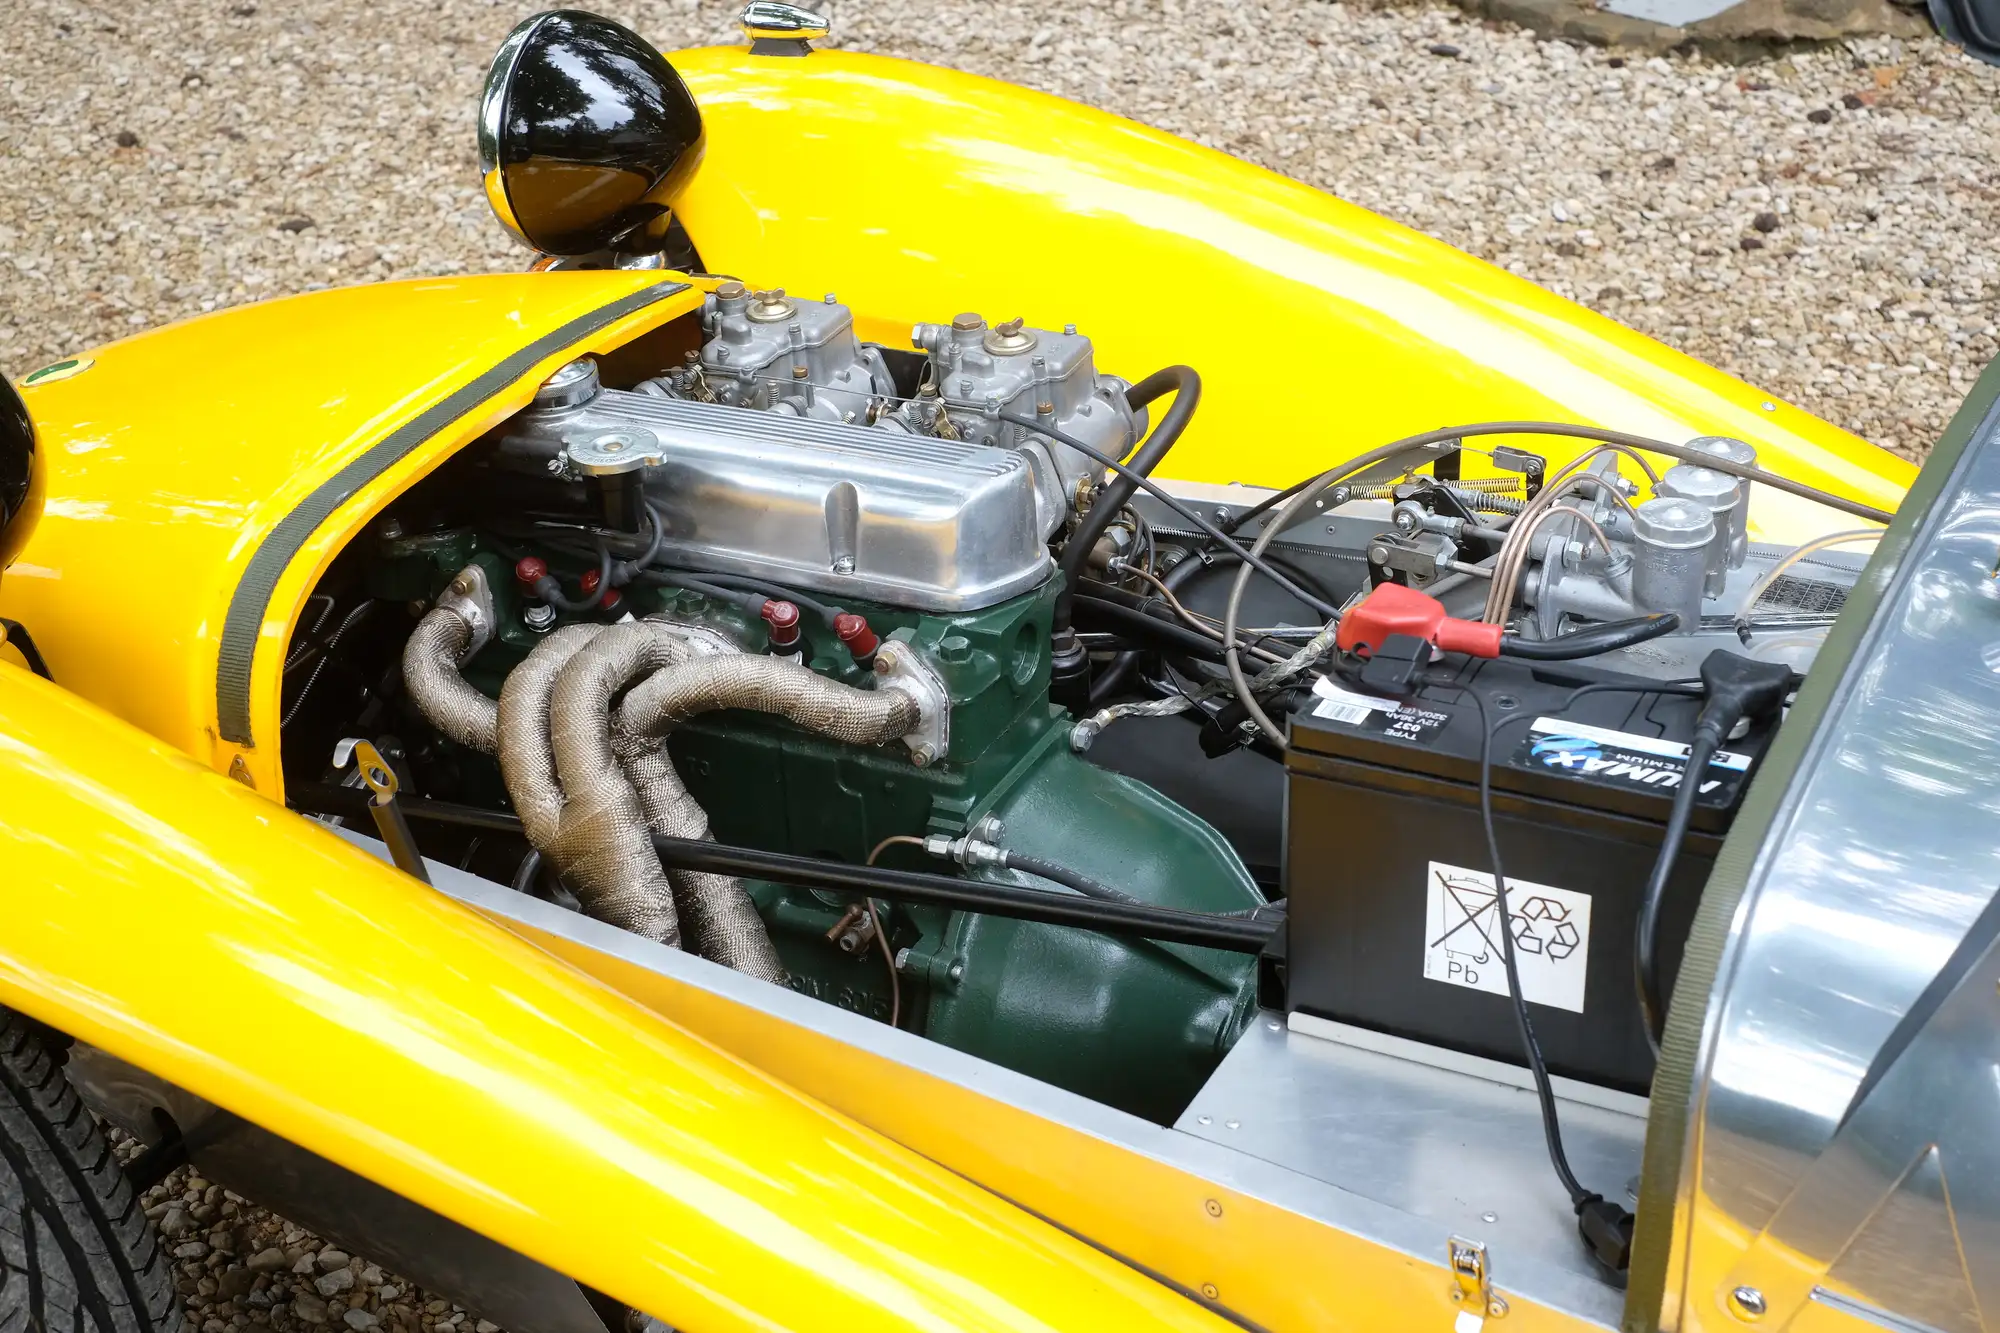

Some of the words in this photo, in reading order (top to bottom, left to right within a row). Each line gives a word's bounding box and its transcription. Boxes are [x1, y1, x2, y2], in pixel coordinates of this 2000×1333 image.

[1394, 706, 1417, 715] (EN
[1418, 709, 1448, 721] 320A
[1392, 722, 1422, 732] 037
[1416, 718, 1440, 727] 12V
[1383, 728, 1417, 741] TYPE
[1616, 753, 1684, 773] REMIUM
[1448, 961, 1479, 985] Pb
